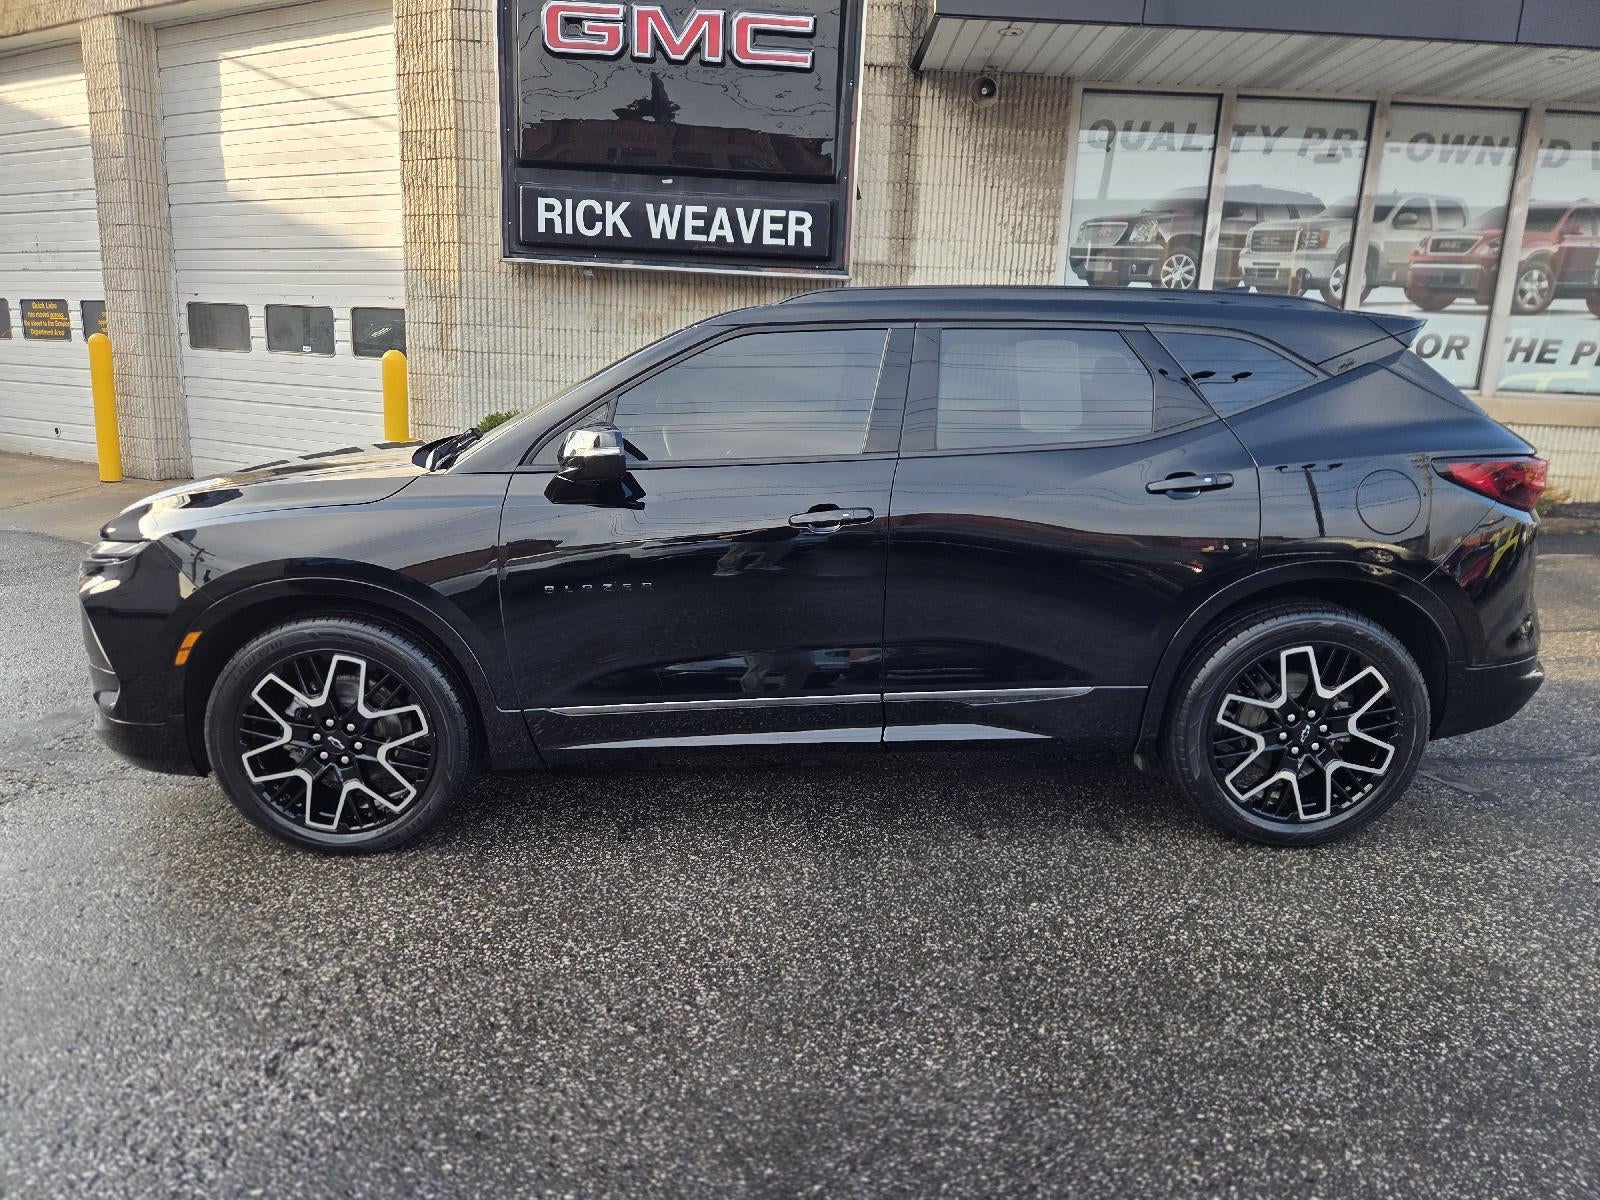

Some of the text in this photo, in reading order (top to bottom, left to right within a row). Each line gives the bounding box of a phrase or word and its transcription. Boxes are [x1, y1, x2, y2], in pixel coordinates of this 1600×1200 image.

[542, 1, 817, 70] GMC
[1087, 118, 1289, 155] QUALTY
[1297, 126, 1572, 169] PR-OWND
[537, 197, 813, 247] RICK WEAVER
[1415, 333, 1470, 361] OR
[1570, 340, 1600, 367] P
[544, 581, 653, 594] BLAZER
